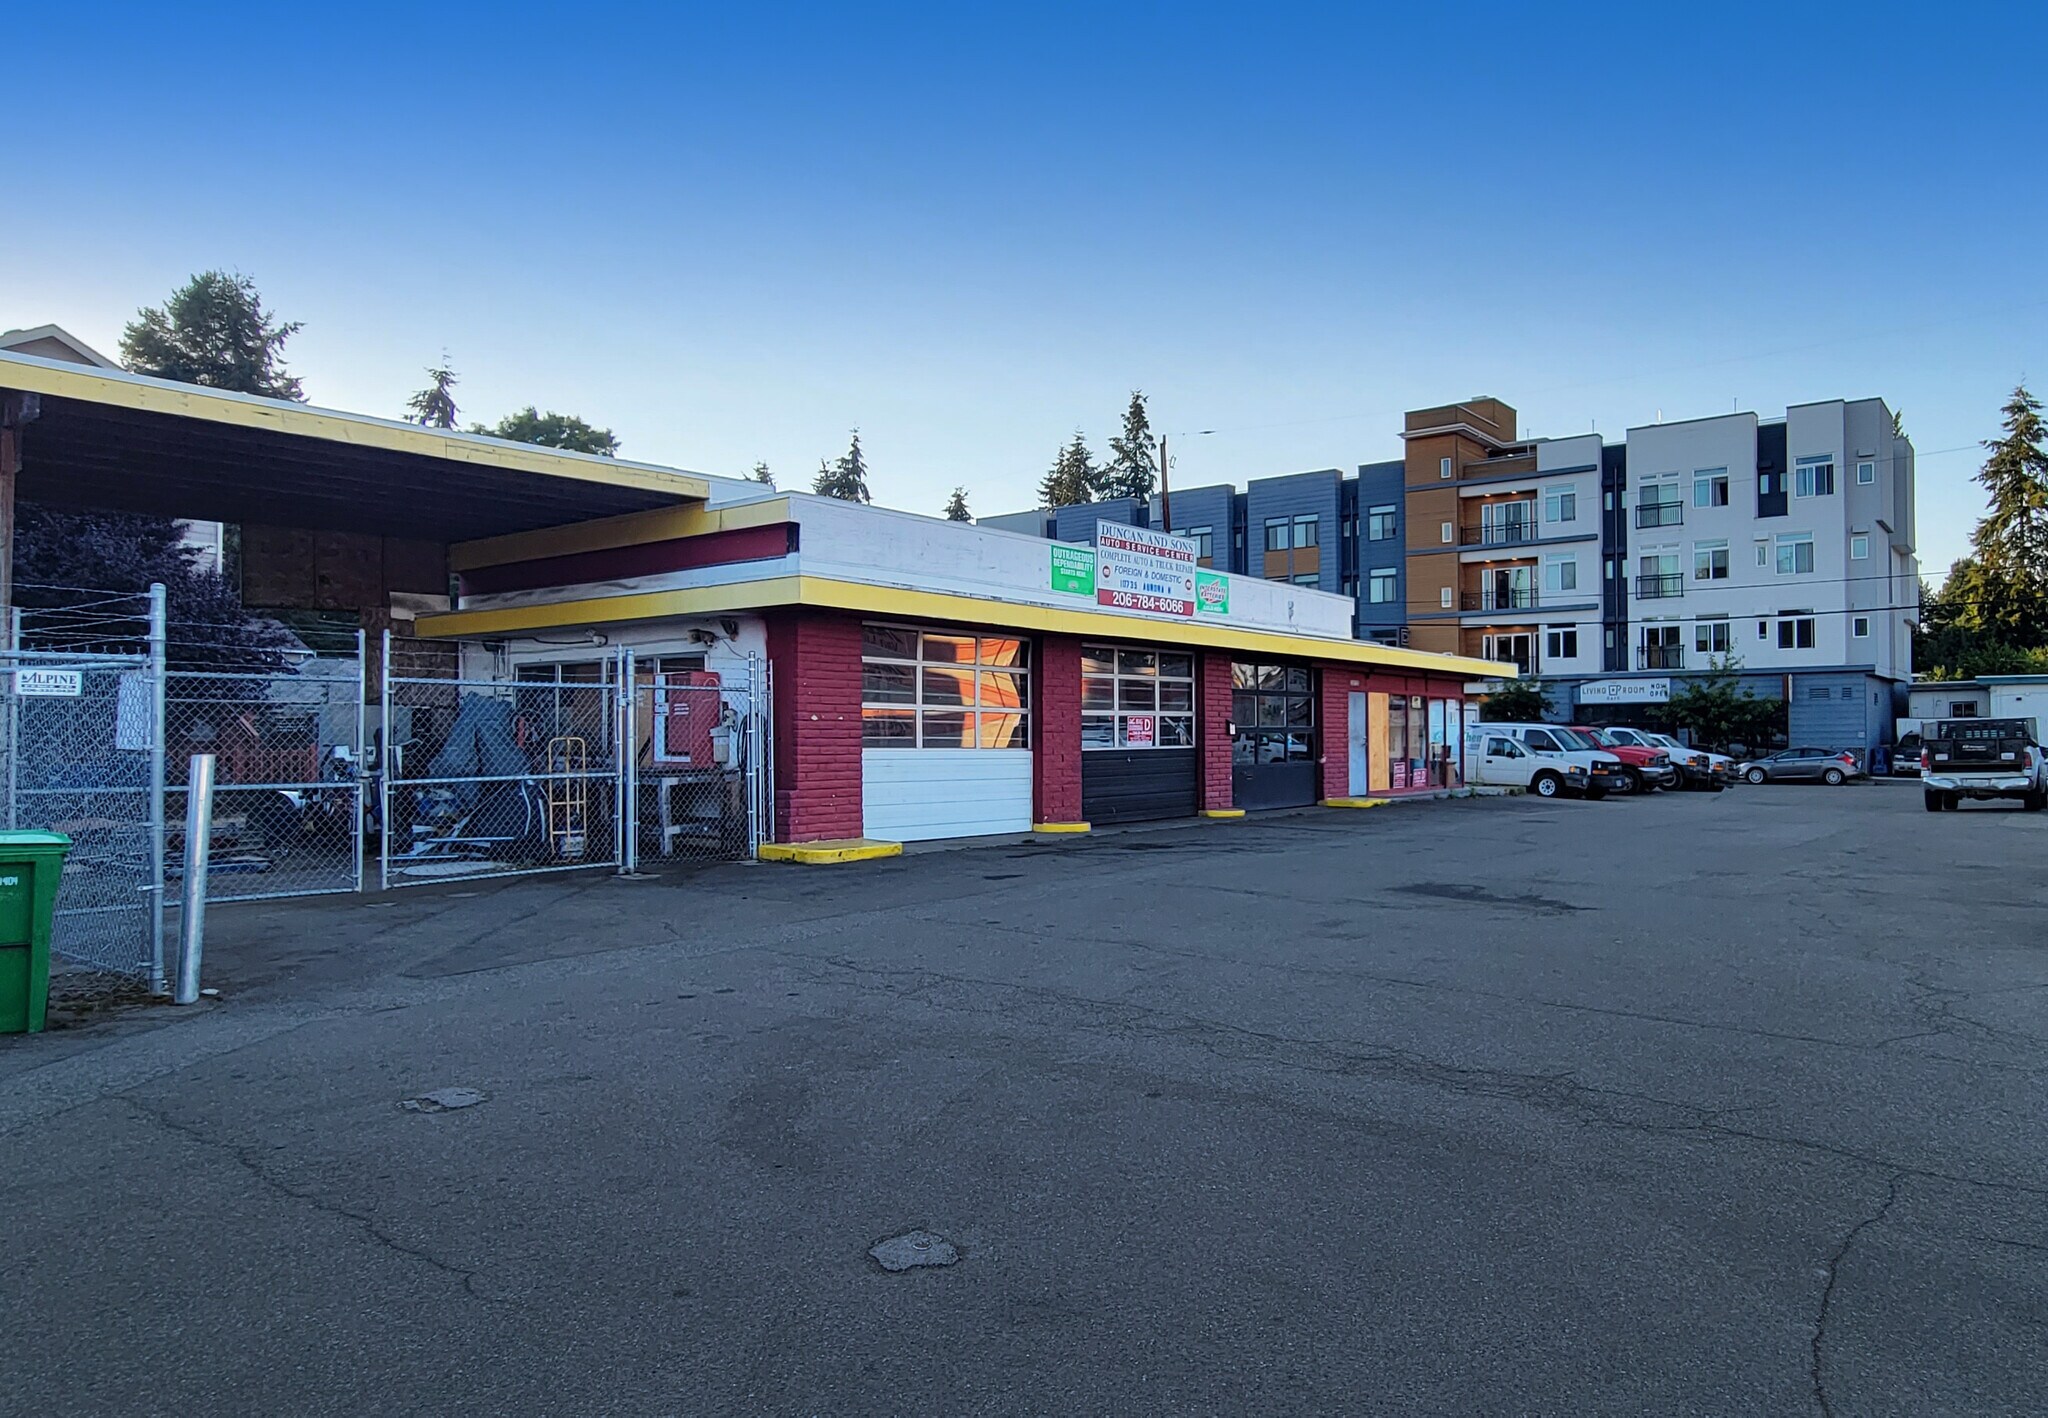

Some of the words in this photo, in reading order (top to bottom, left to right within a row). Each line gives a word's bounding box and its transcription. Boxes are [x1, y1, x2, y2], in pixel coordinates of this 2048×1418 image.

[1101, 524, 1143, 542] DUNCAN
[1147, 535, 1168, 548] AND
[1170, 539, 1194, 552] SONS
[1053, 547, 1094, 563] OUTRAGEOUS
[1101, 537, 1120, 548] AUTO
[1125, 542, 1160, 556] SERVICE
[1165, 550, 1194, 562] CENTER
[1053, 557, 1094, 572] DEPENDABILITY
[1100, 549, 1131, 564] COMPLETE
[1133, 554, 1149, 567] AUTO
[1156, 559, 1175, 571] TRUCK
[1175, 563, 1194, 574] REPAIR
[1114, 565, 1143, 579] FOREIGN
[1144, 570, 1149, 579] &
[1151, 571, 1182, 584] DOMESTIC
[1112, 591, 1184, 613] 206-784-6066
[22, 672, 77, 684] ALPINE
[1582, 687, 1606, 695] LIVING
[1622, 686, 1645, 694] ROOM
